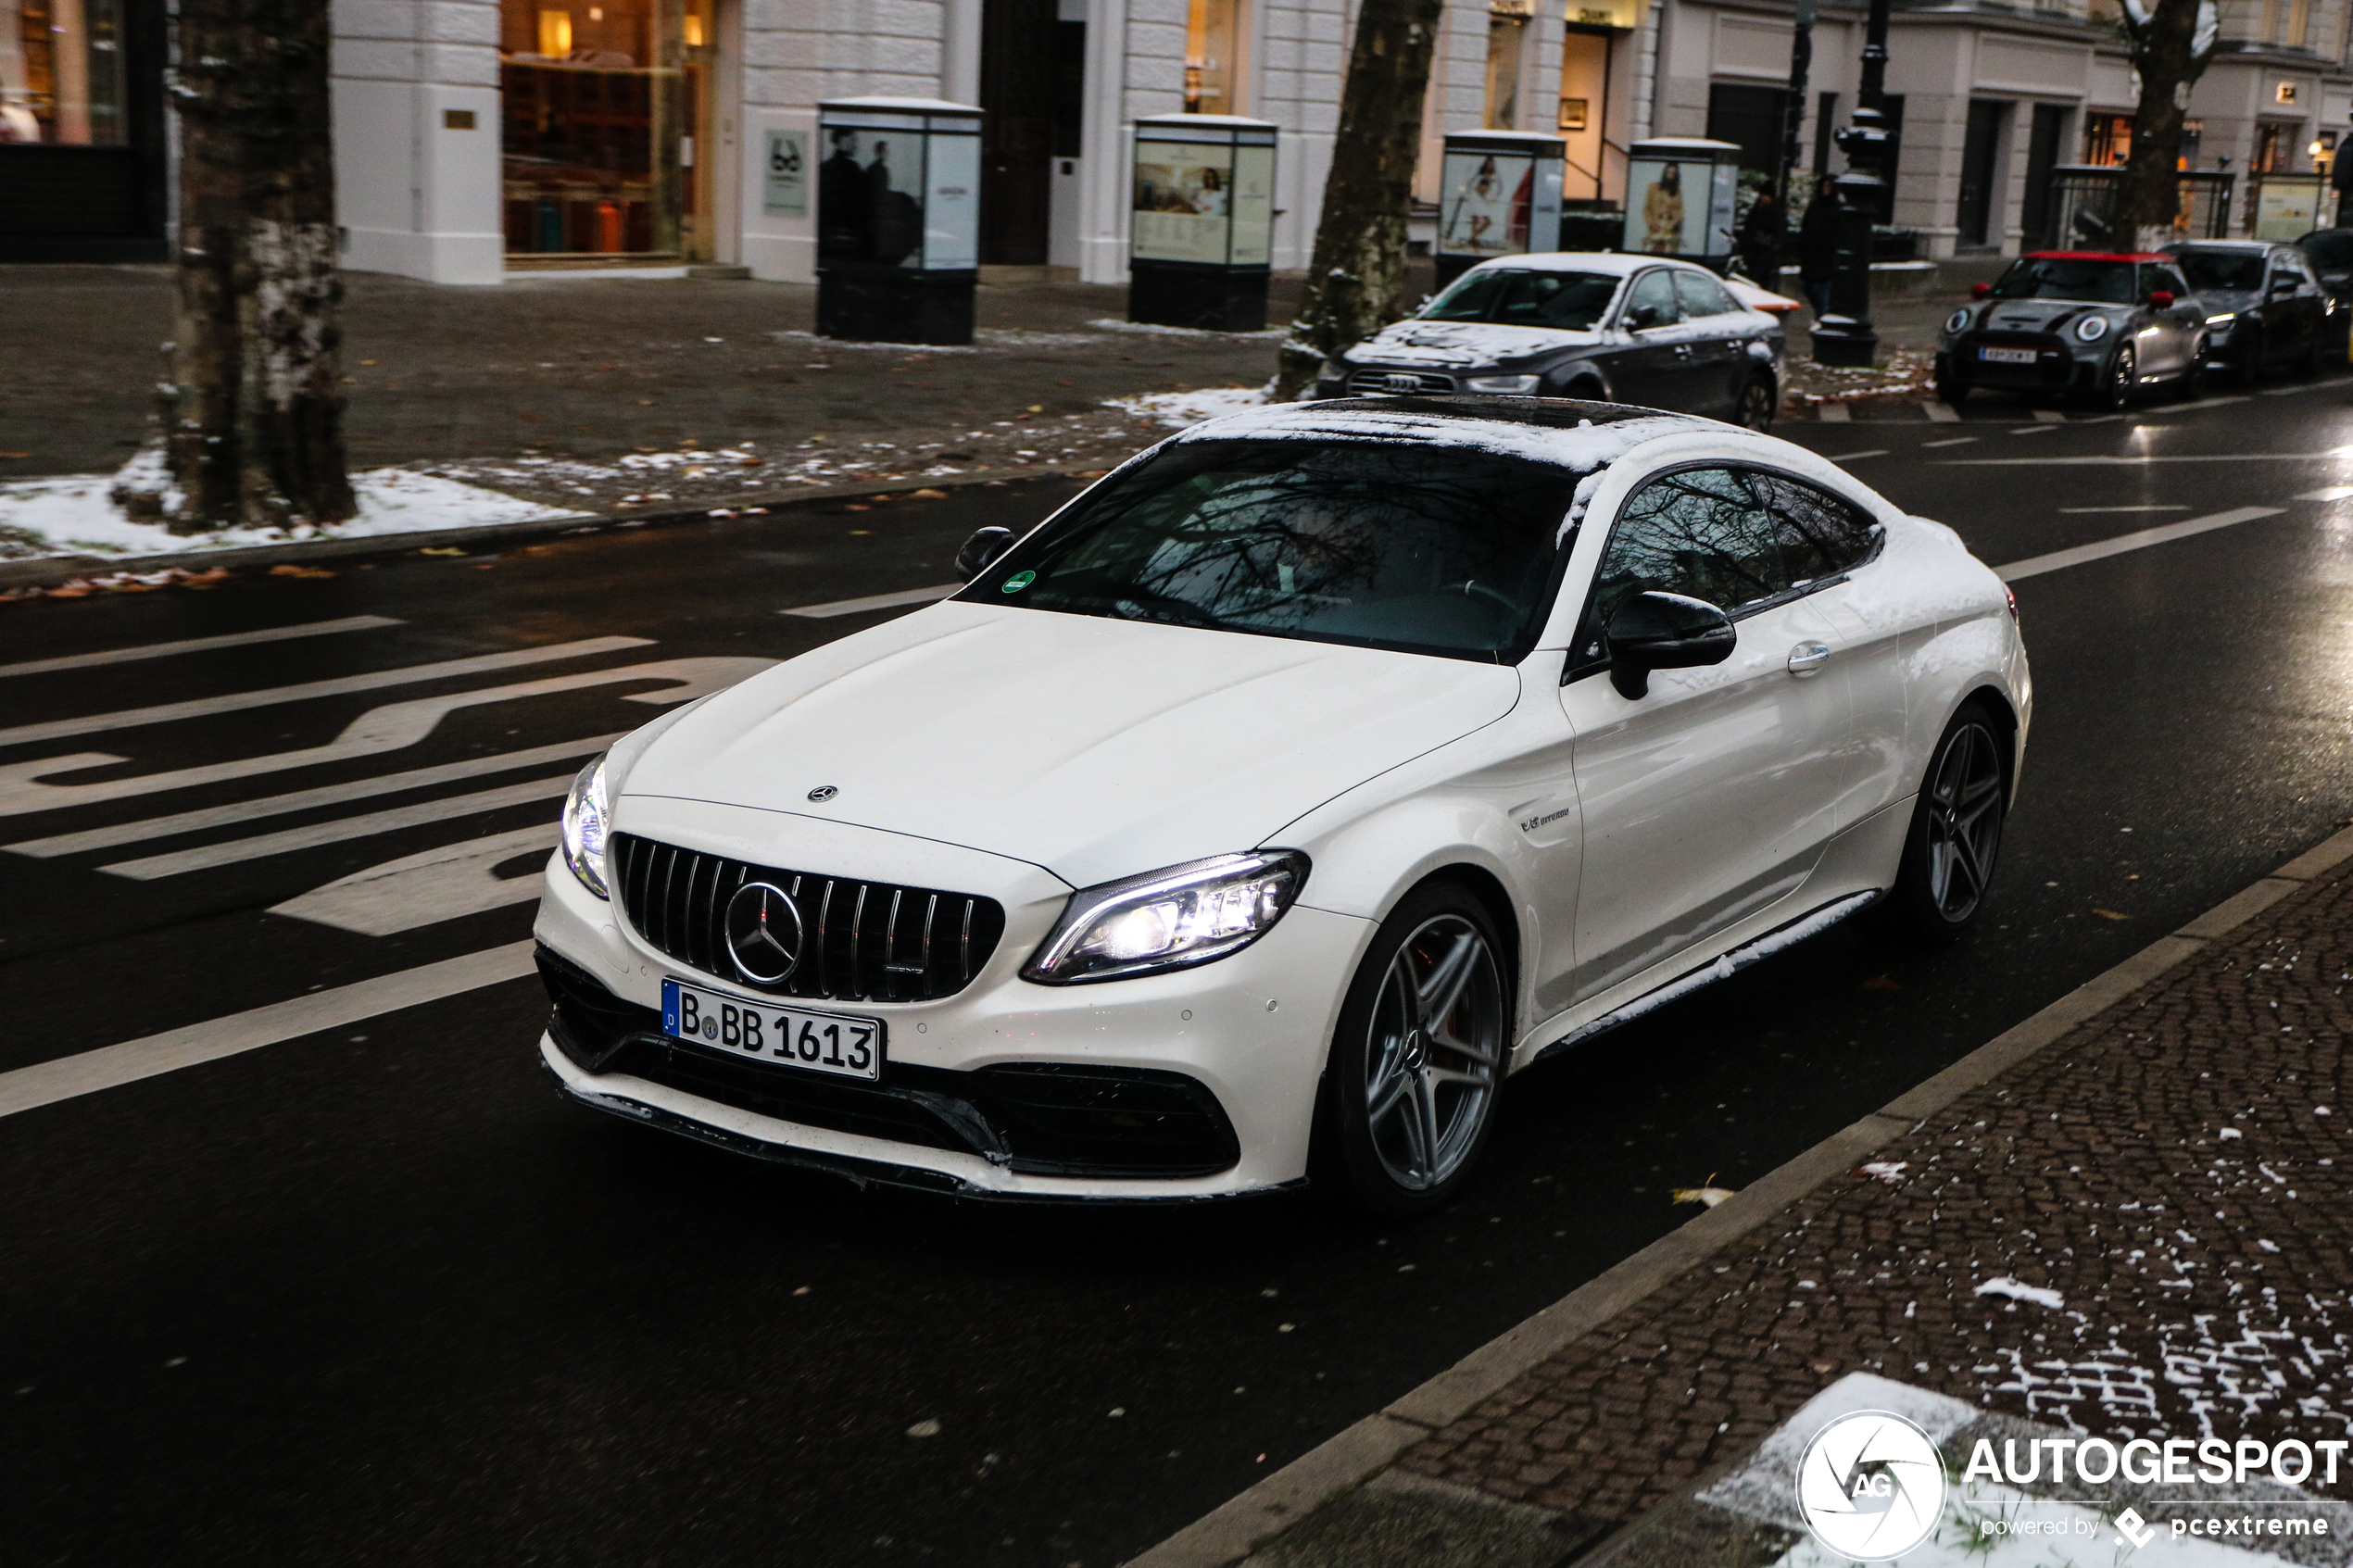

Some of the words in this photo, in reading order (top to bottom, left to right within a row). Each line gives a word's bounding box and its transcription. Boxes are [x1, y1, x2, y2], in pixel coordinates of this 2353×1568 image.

[667, 1013, 674, 1026] D
[681, 991, 700, 1035] B
[722, 1002, 764, 1052] BB
[774, 1016, 872, 1070] 1613
